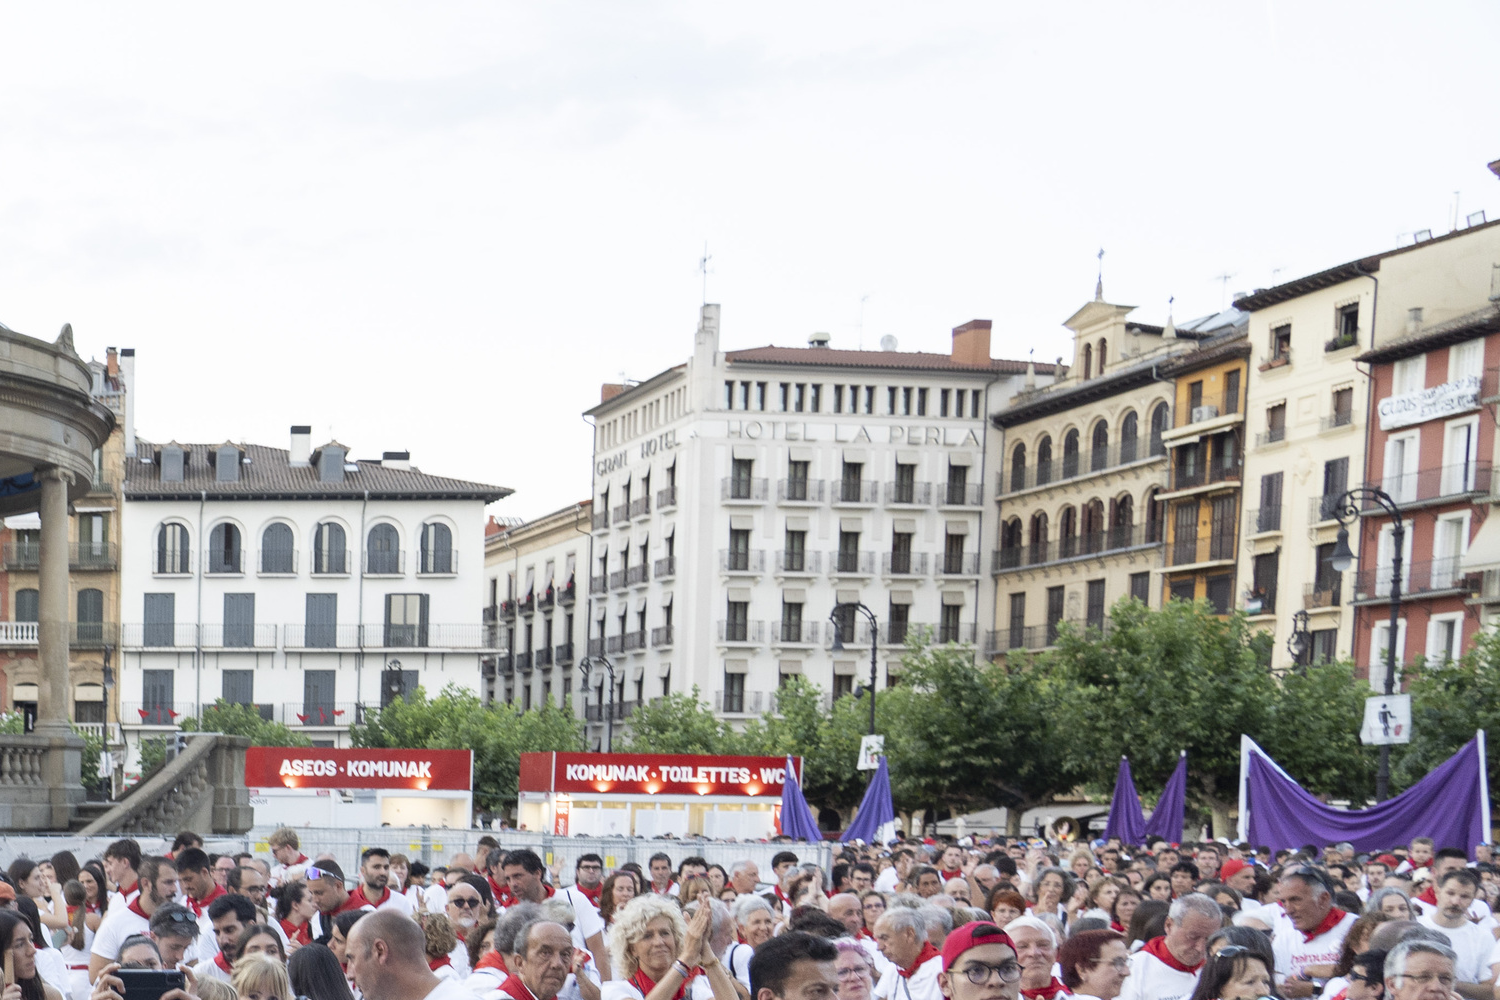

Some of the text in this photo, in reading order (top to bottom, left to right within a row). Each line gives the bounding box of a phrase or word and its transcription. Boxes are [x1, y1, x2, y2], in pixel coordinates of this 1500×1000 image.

[727, 420, 980, 447] HOTEL LA PERLA
[596, 429, 681, 477] GRAN HOTEL
[280, 759, 432, 778] ASEOS KOMUNAK
[566, 763, 787, 785] KOMUNAK TOILETTES WC
